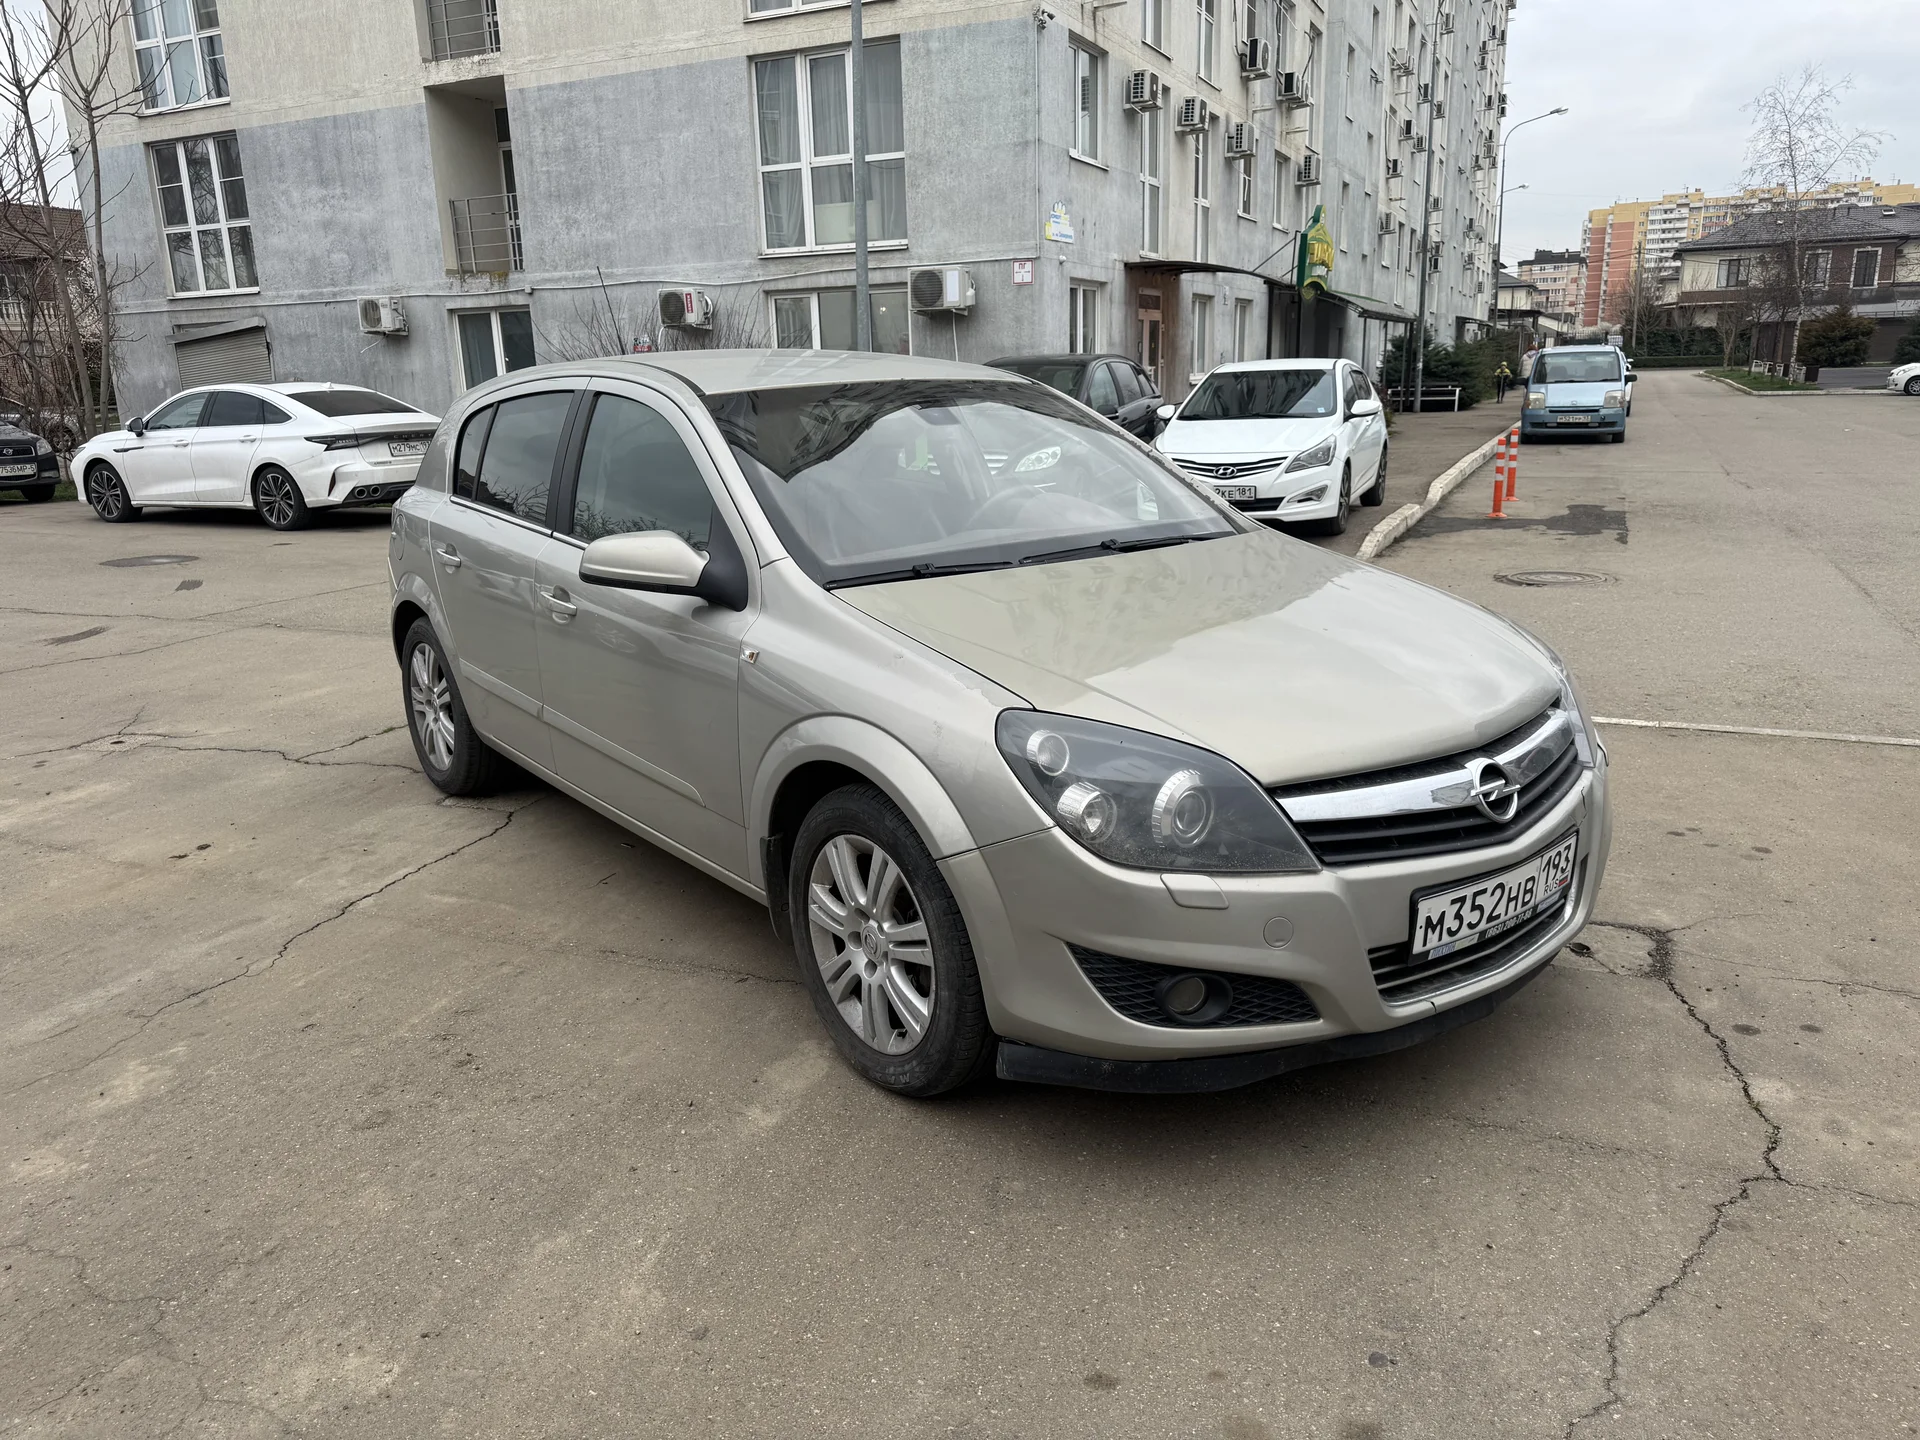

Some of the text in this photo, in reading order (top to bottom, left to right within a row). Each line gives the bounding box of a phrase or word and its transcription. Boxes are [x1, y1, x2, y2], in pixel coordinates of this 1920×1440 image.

[1236, 487, 1252, 496] 181
[1542, 842, 1572, 885] 193
[1544, 878, 1560, 896] RUS
